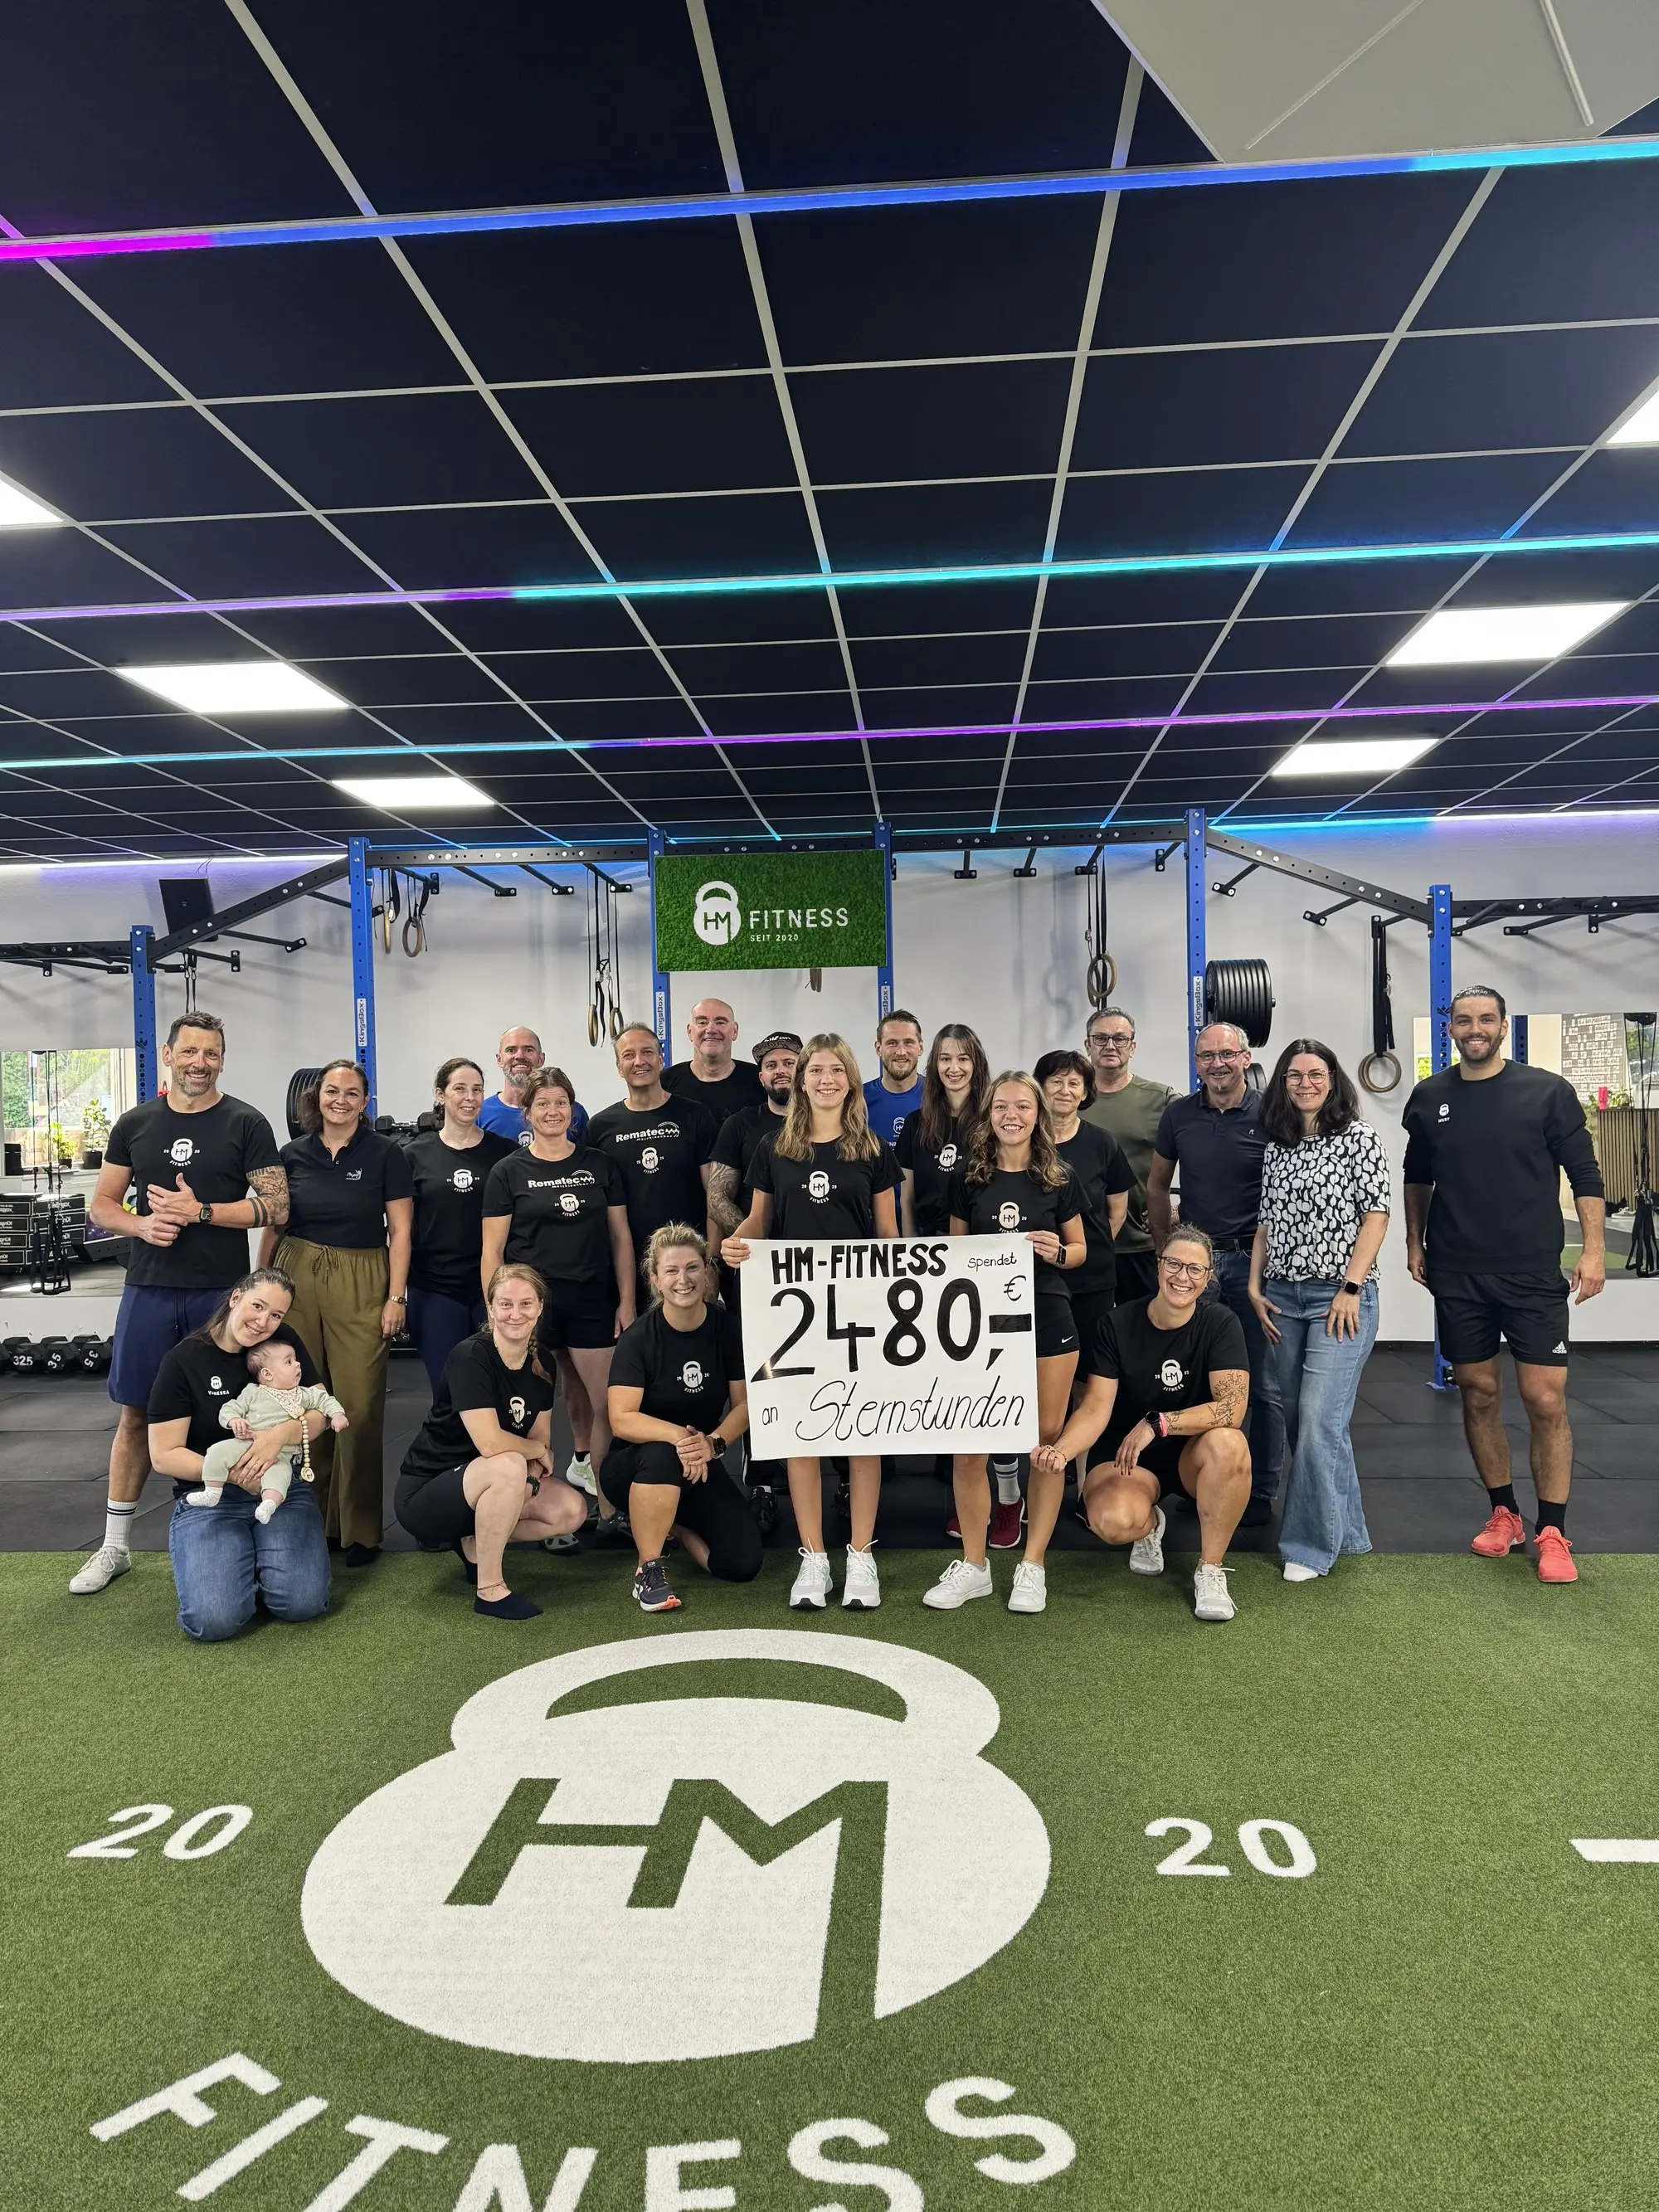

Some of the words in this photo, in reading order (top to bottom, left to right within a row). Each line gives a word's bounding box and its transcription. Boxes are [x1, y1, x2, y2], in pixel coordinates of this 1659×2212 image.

[703, 911, 731, 942] HM
[749, 907, 849, 929] FITNESS
[750, 934, 771, 942] SEIT
[776, 933, 799, 941] 2020
[615, 1128, 665, 1143] Rematec
[528, 1177, 580, 1189] Rematec
[771, 1243, 949, 1285] HM-FITNESS
[967, 1253, 1017, 1272] spendet
[761, 1405, 779, 1426] an
[795, 1375, 1025, 1441] Sternstunden
[67, 1803, 253, 1860] 20
[1144, 1817, 1318, 1879] 20
[443, 1777, 889, 2040] HM
